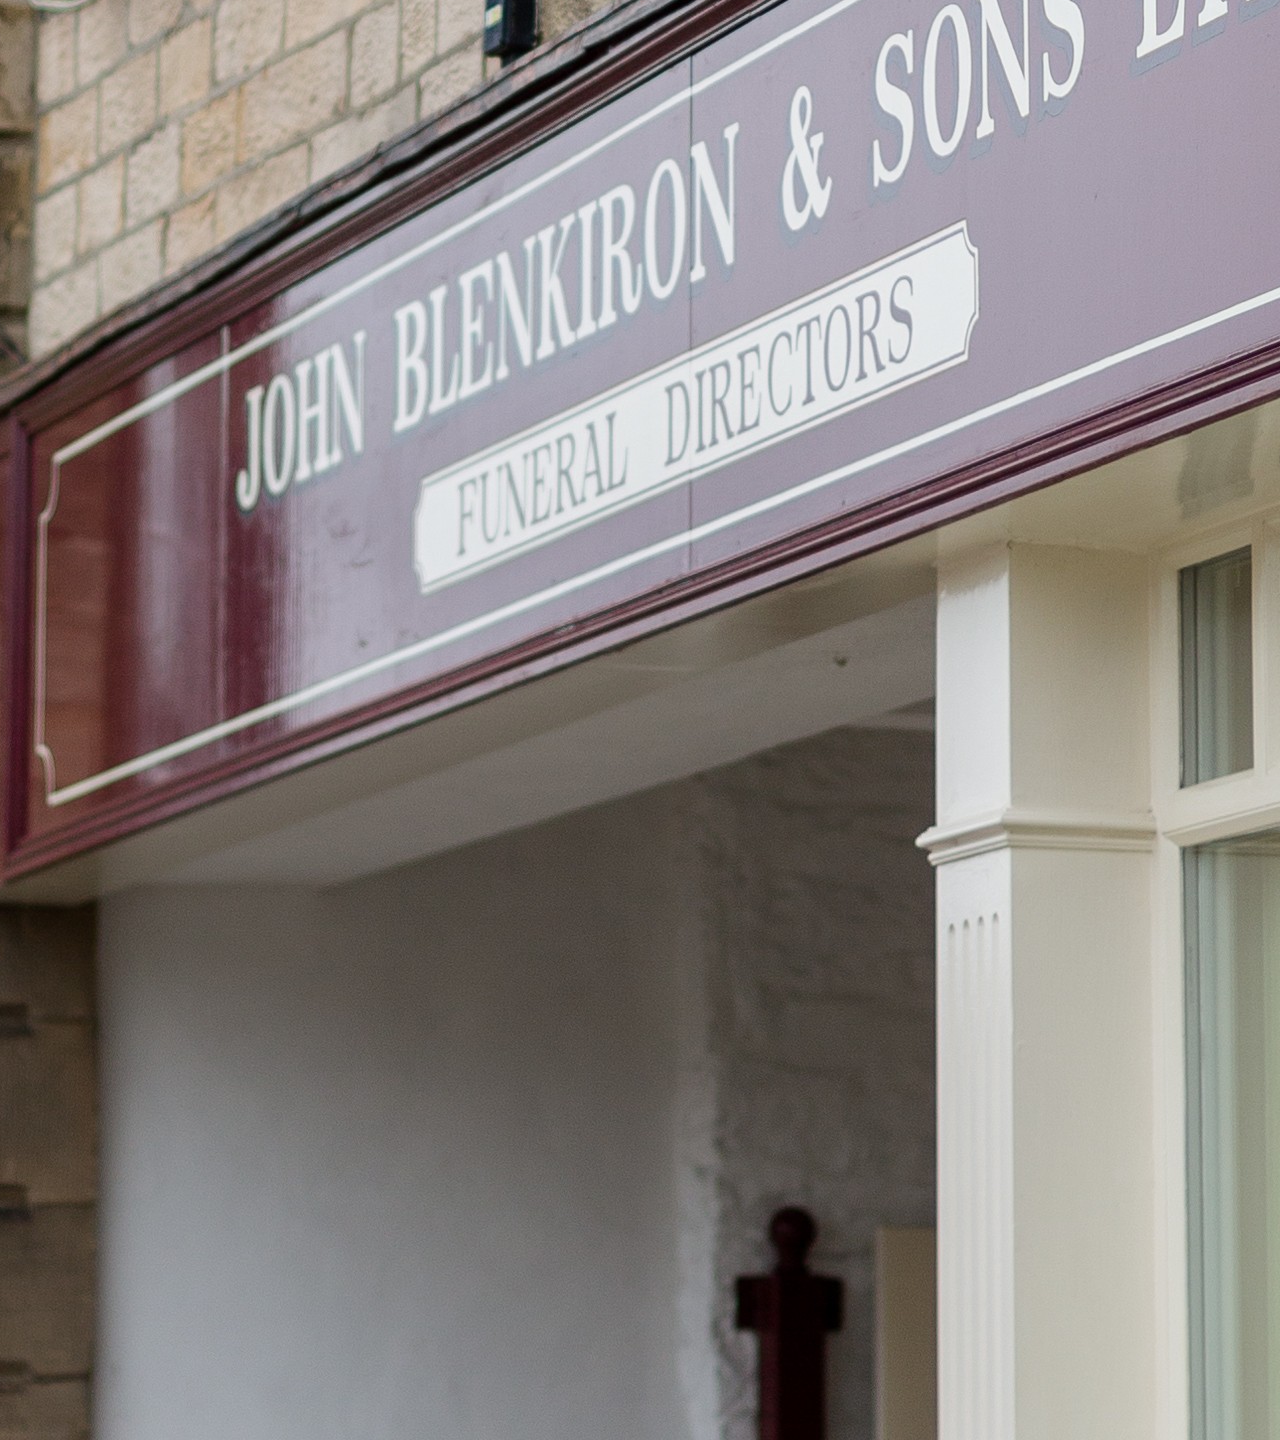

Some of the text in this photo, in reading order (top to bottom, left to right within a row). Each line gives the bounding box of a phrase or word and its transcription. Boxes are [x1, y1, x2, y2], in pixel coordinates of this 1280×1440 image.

[236, 330, 367, 511] JOHN
[393, 122, 739, 433] BLENKIRON
[782, 84, 832, 230] &
[457, 275, 914, 557] FUNERAL DIRECTORS
